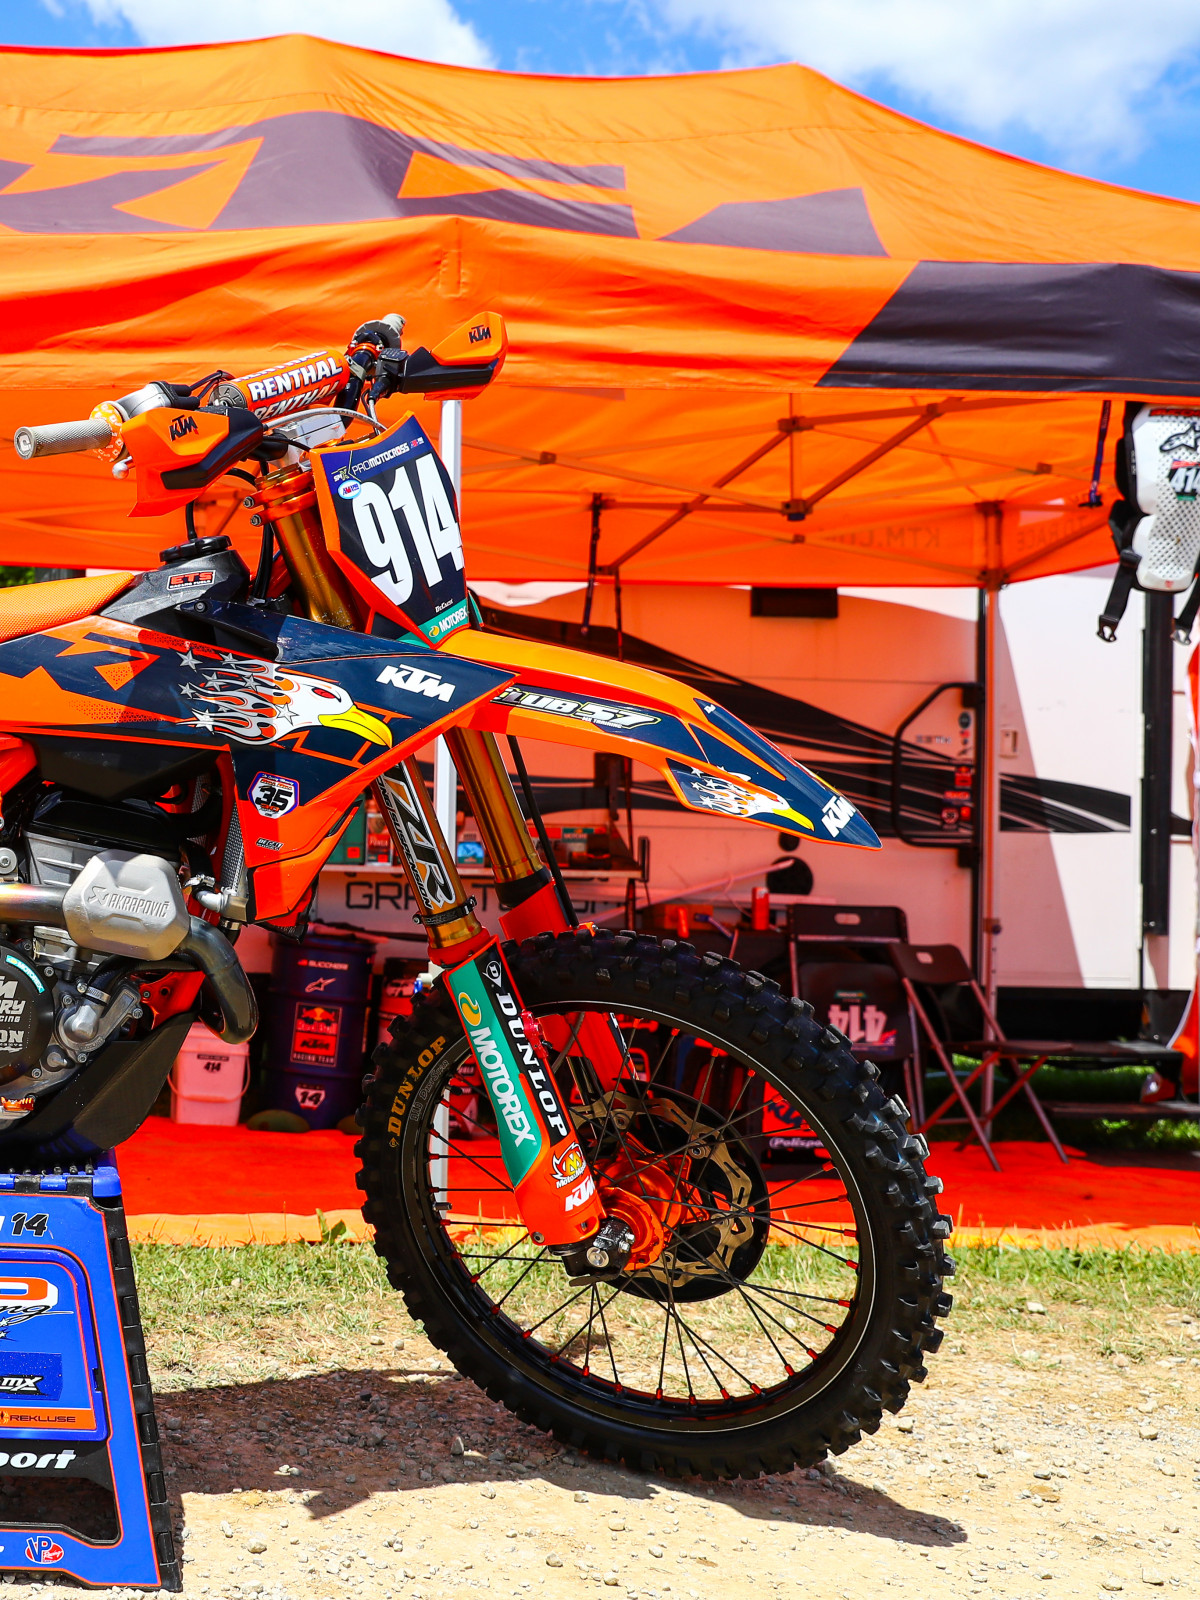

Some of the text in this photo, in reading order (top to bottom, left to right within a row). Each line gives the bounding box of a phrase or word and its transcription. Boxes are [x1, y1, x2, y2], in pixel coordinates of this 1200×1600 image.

[468, 325, 492, 344] KTM
[248, 357, 343, 402] RENTHAL
[168, 414, 198, 442] KTM
[352, 453, 464, 606] 914
[170, 572, 213, 585] ETS
[439, 606, 468, 632] MOTOREX
[376, 664, 457, 702] KTM
[577, 702, 658, 726] 57
[255, 785, 293, 811] 35
[821, 795, 857, 838] KTM
[389, 809, 434, 911] SUSPENSION
[17, 961, 44, 992] MOTOREX
[496, 993, 568, 1137] DUNLOP
[300, 1091, 322, 1105] 14
[387, 1036, 446, 1137] DUNLOP
[470, 1027, 536, 1148] MOTOREX
[565, 1175, 595, 1212] KTM
[11, 1212, 49, 1237] 14
[10, 1414, 76, 1423] REKLUSE
[26, 1536, 52, 1562] VP
